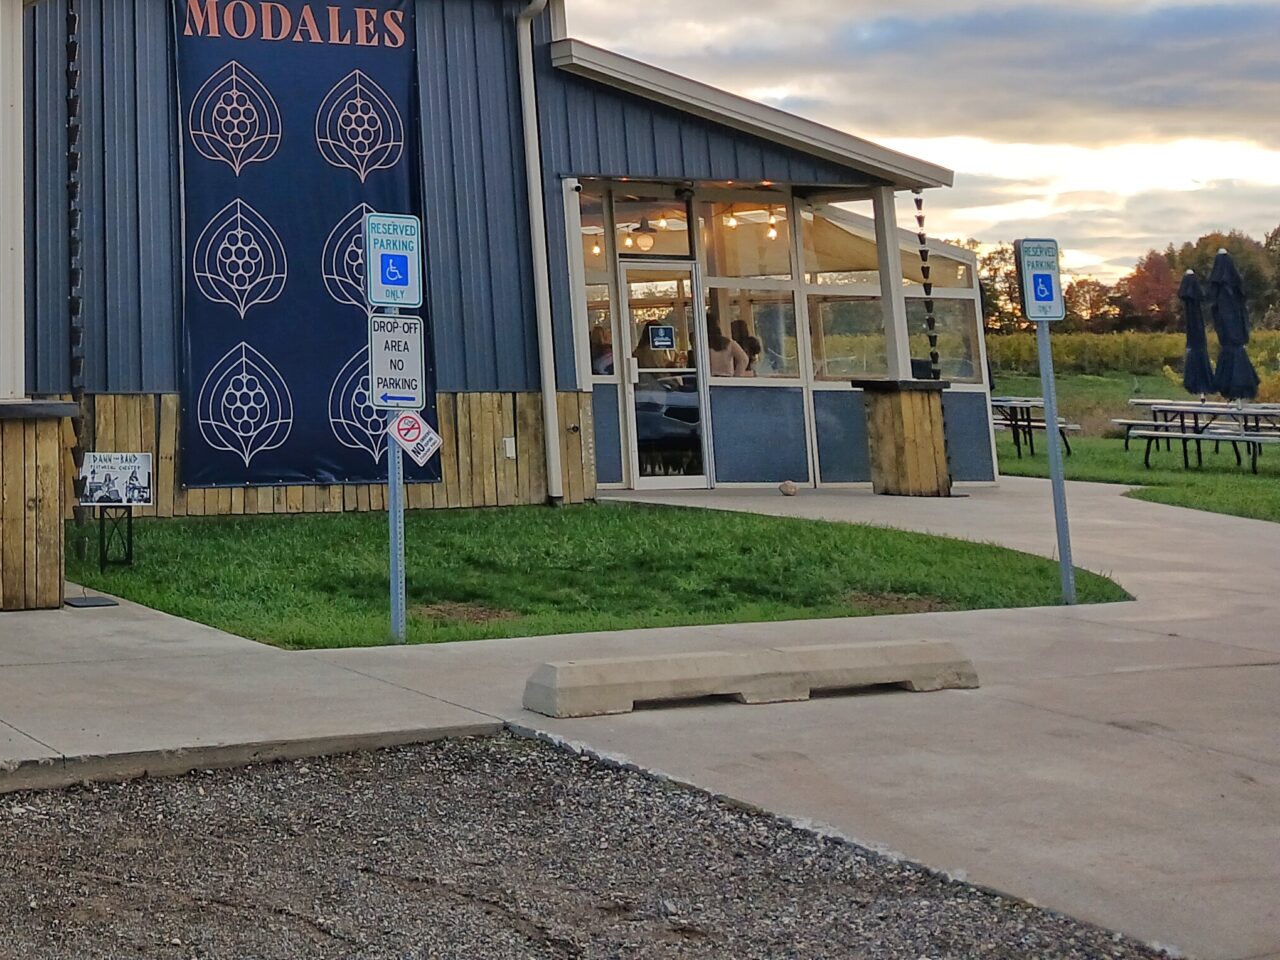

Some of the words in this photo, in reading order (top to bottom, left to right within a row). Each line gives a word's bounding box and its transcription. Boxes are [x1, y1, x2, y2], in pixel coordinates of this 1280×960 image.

[371, 223, 416, 236] RESERVED
[373, 238, 414, 252] PARKING
[1023, 246, 1057, 257] RESERVED
[1027, 261, 1056, 271] PARKING
[385, 289, 405, 299] ONLY
[373, 321, 419, 334] DROP-OFF
[384, 340, 410, 353] AREA
[389, 359, 404, 371] NO
[376, 377, 418, 390] PARKING
[410, 442, 425, 458] NO
